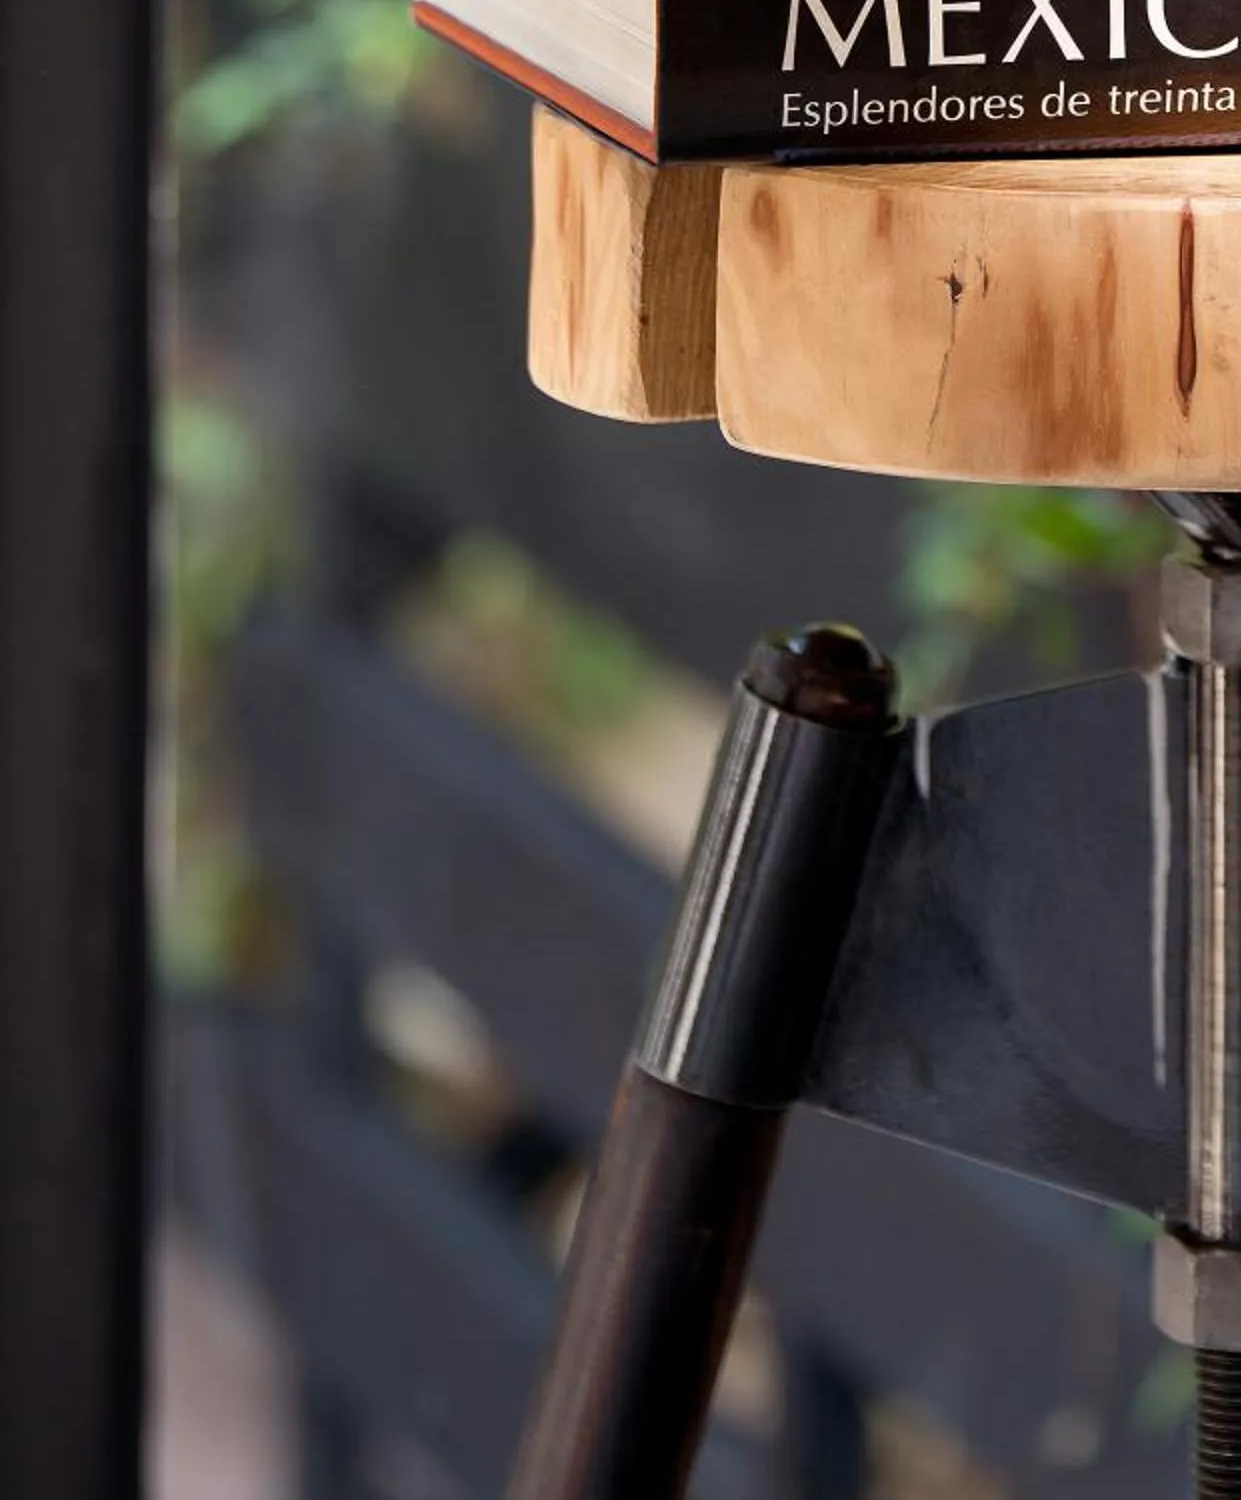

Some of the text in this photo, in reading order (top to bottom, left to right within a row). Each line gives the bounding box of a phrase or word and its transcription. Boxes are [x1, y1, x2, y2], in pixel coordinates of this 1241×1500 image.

[781, 85, 1025, 134] Esplendores
[1041, 81, 1090, 119] de
[1108, 78, 1236, 114] treinta
